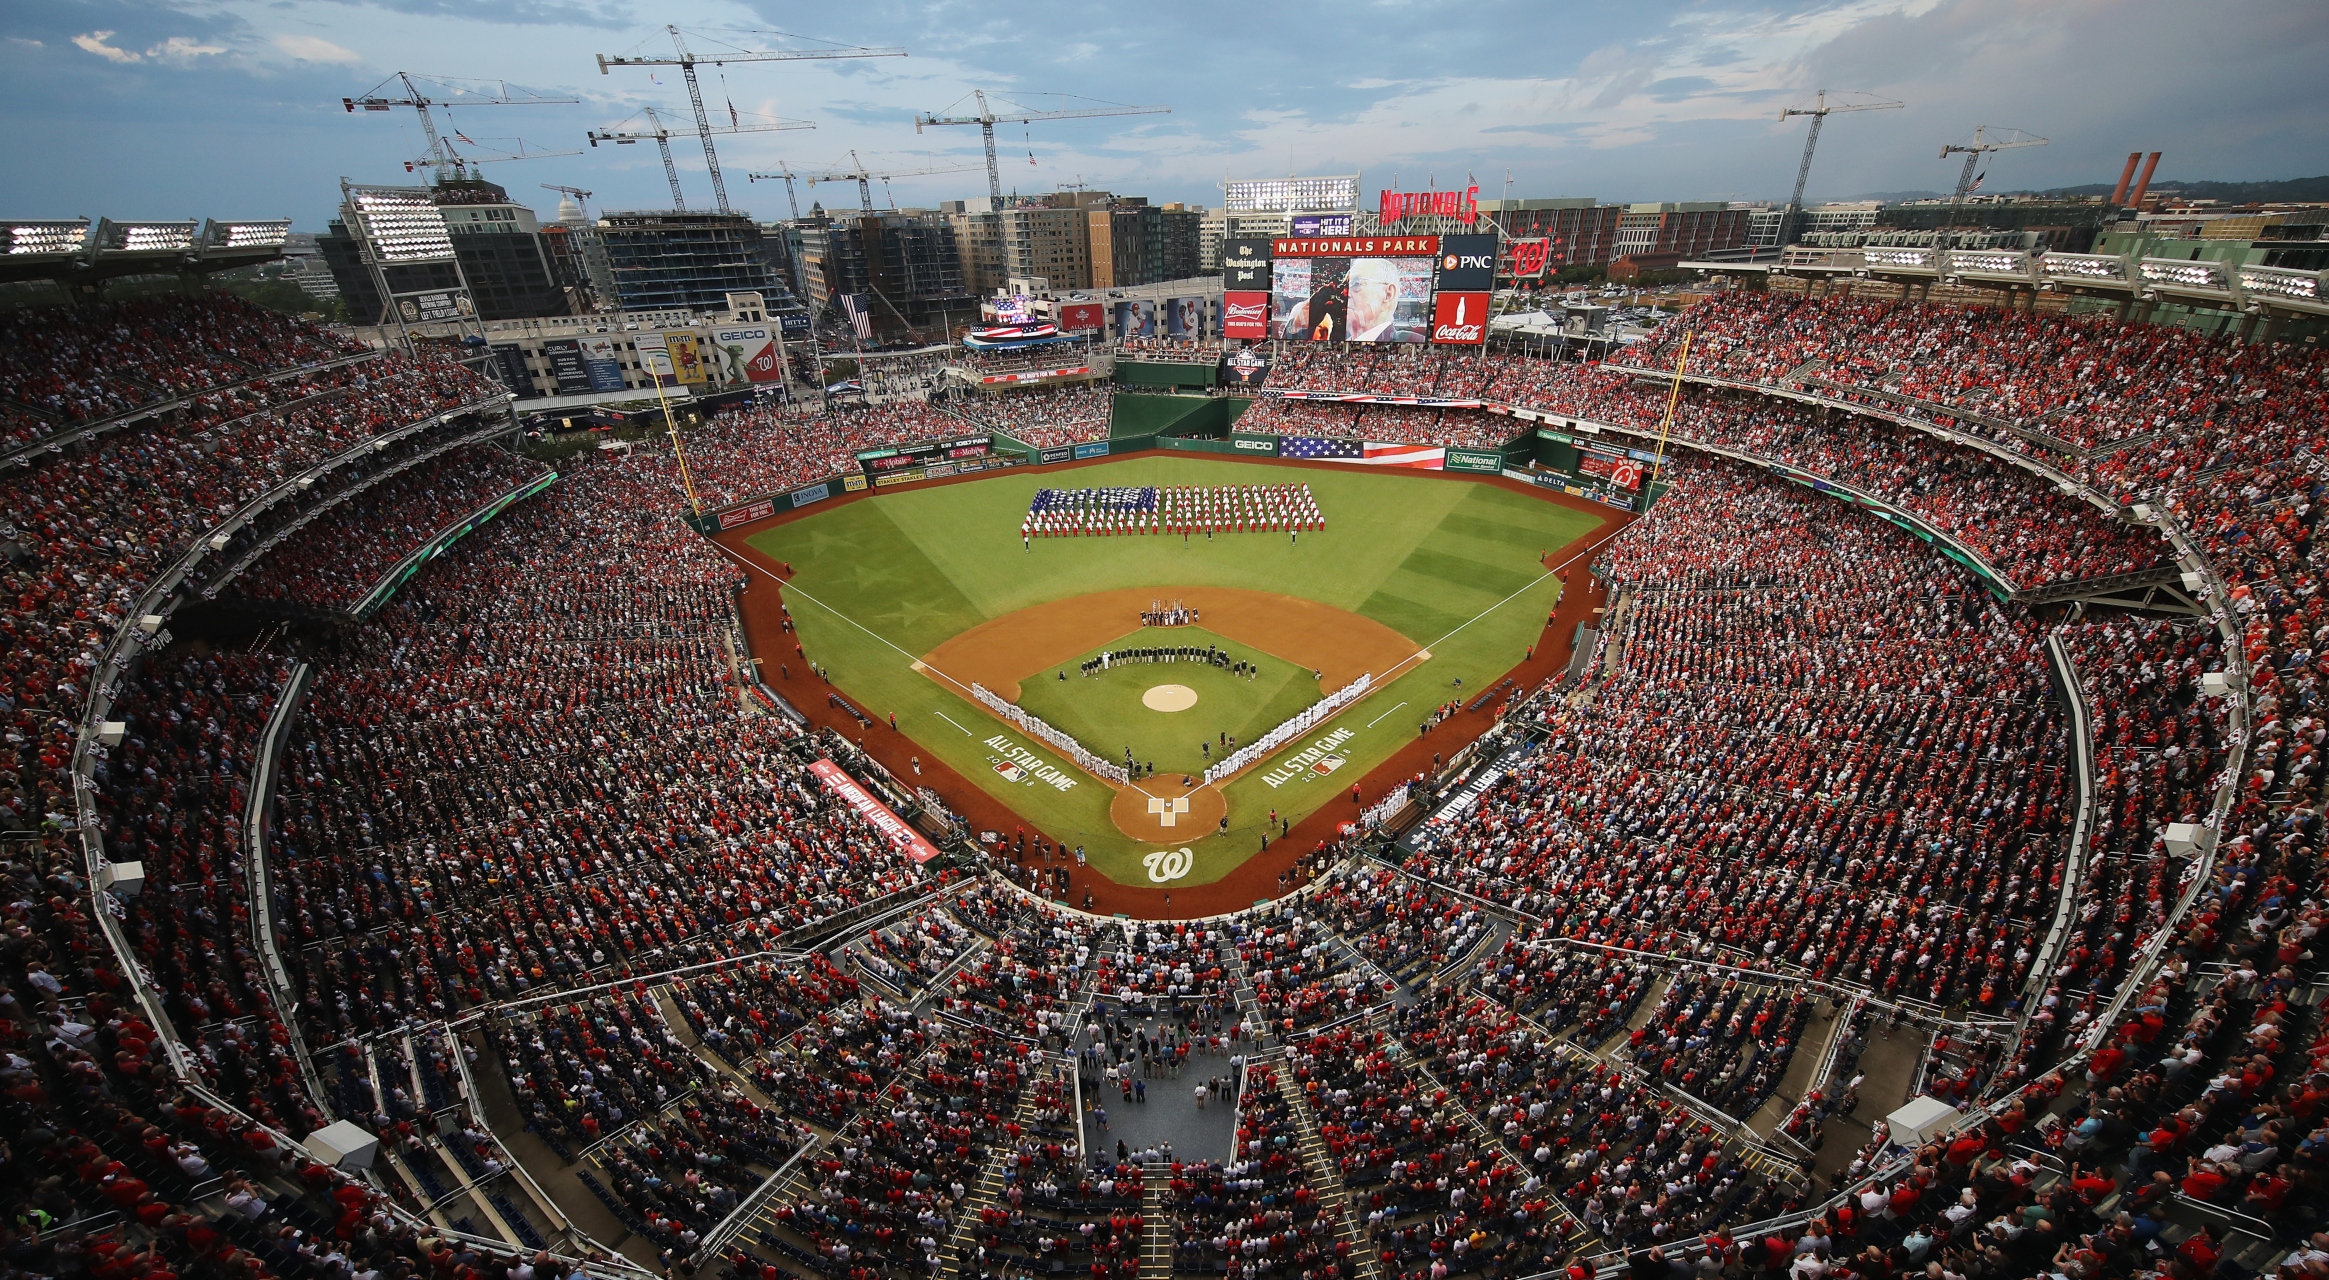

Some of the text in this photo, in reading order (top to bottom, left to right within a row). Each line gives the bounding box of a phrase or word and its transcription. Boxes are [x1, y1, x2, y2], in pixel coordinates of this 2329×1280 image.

[1378, 186, 1480, 226] NATIONALS
[1320, 225, 1350, 235] HERE
[1239, 246, 1253, 256] The
[1278, 240, 1429, 253] NATIONALS PARK
[1225, 256, 1267, 269] Washington
[1460, 255, 1492, 269] PNC
[1238, 271, 1254, 282] Post
[420, 311, 432, 320] LEFT
[432, 309, 444, 318] FIELD
[1228, 306, 1262, 316] Budweiser
[720, 330, 765, 341] GEICO
[1227, 358, 1237, 366] ALL
[1237, 359, 1250, 367] STAR
[1234, 440, 1273, 450] GEICO
[1461, 455, 1497, 465] National
[1544, 477, 1565, 487] DELTA
[801, 488, 823, 499] INOVA
[1609, 499, 1627, 507] mastercard
[983, 734, 1078, 792] ALL STAR GAME
[1261, 727, 1356, 789] ALL STAR GAME
[986, 755, 1035, 787] 20 18
[1301, 749, 1351, 783] 20 18
[1435, 767, 1503, 822] NATIONAL LEAGUE
[837, 782, 902, 834] AMERICAN LEAGUE
[1142, 847, 1193, 883] W
